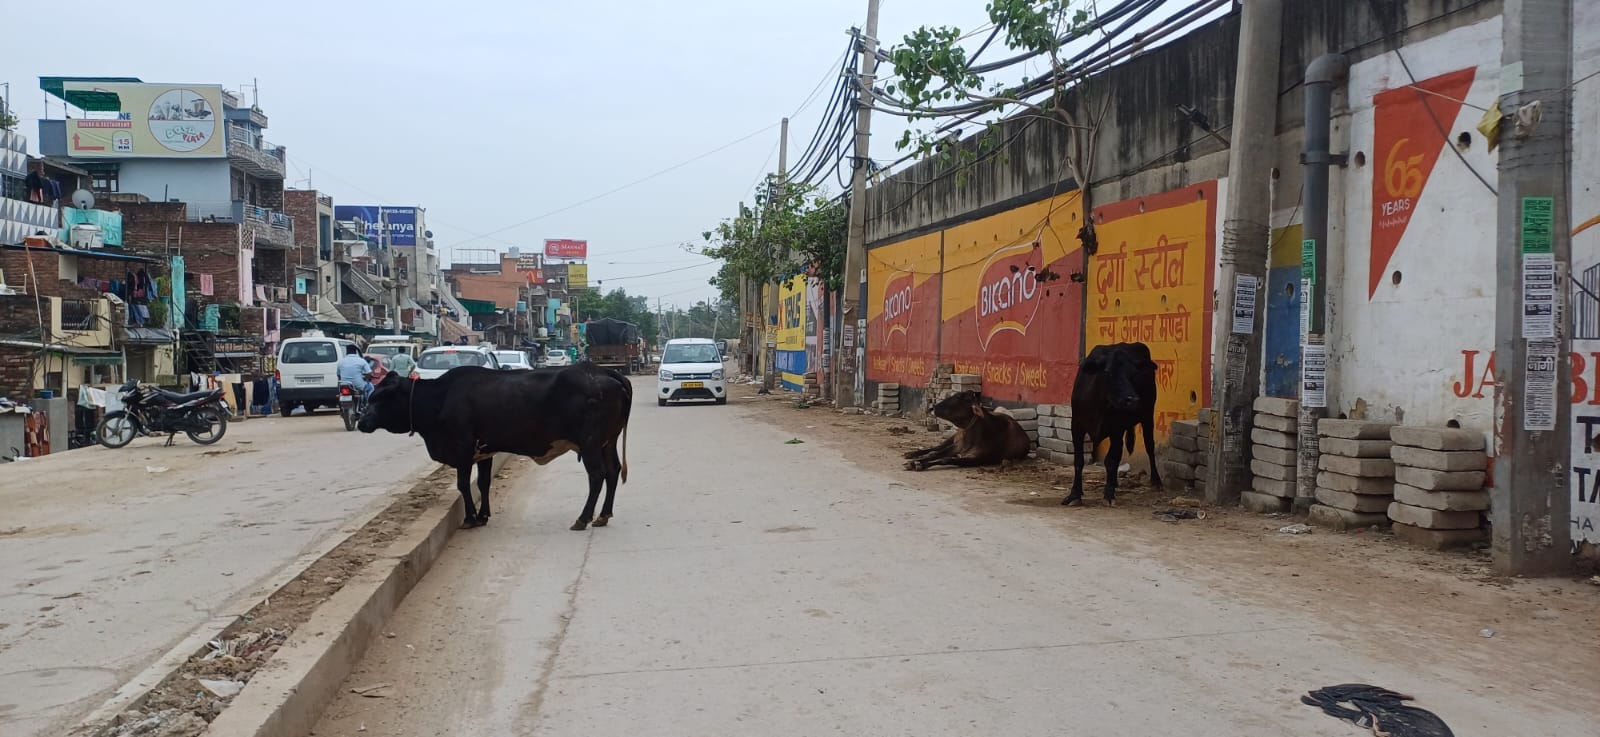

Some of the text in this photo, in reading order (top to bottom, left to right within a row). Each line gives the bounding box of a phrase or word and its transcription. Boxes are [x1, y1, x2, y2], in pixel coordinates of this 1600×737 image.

[1384, 138, 1425, 198] 65
[1381, 198, 1411, 217] YEARS
[1096, 233, 1189, 311] दुर्गा स्टील
[1121, 313, 1157, 342] अनाज
[986, 362, 1013, 384] Snacks
[1020, 363, 1048, 388] Sweets
